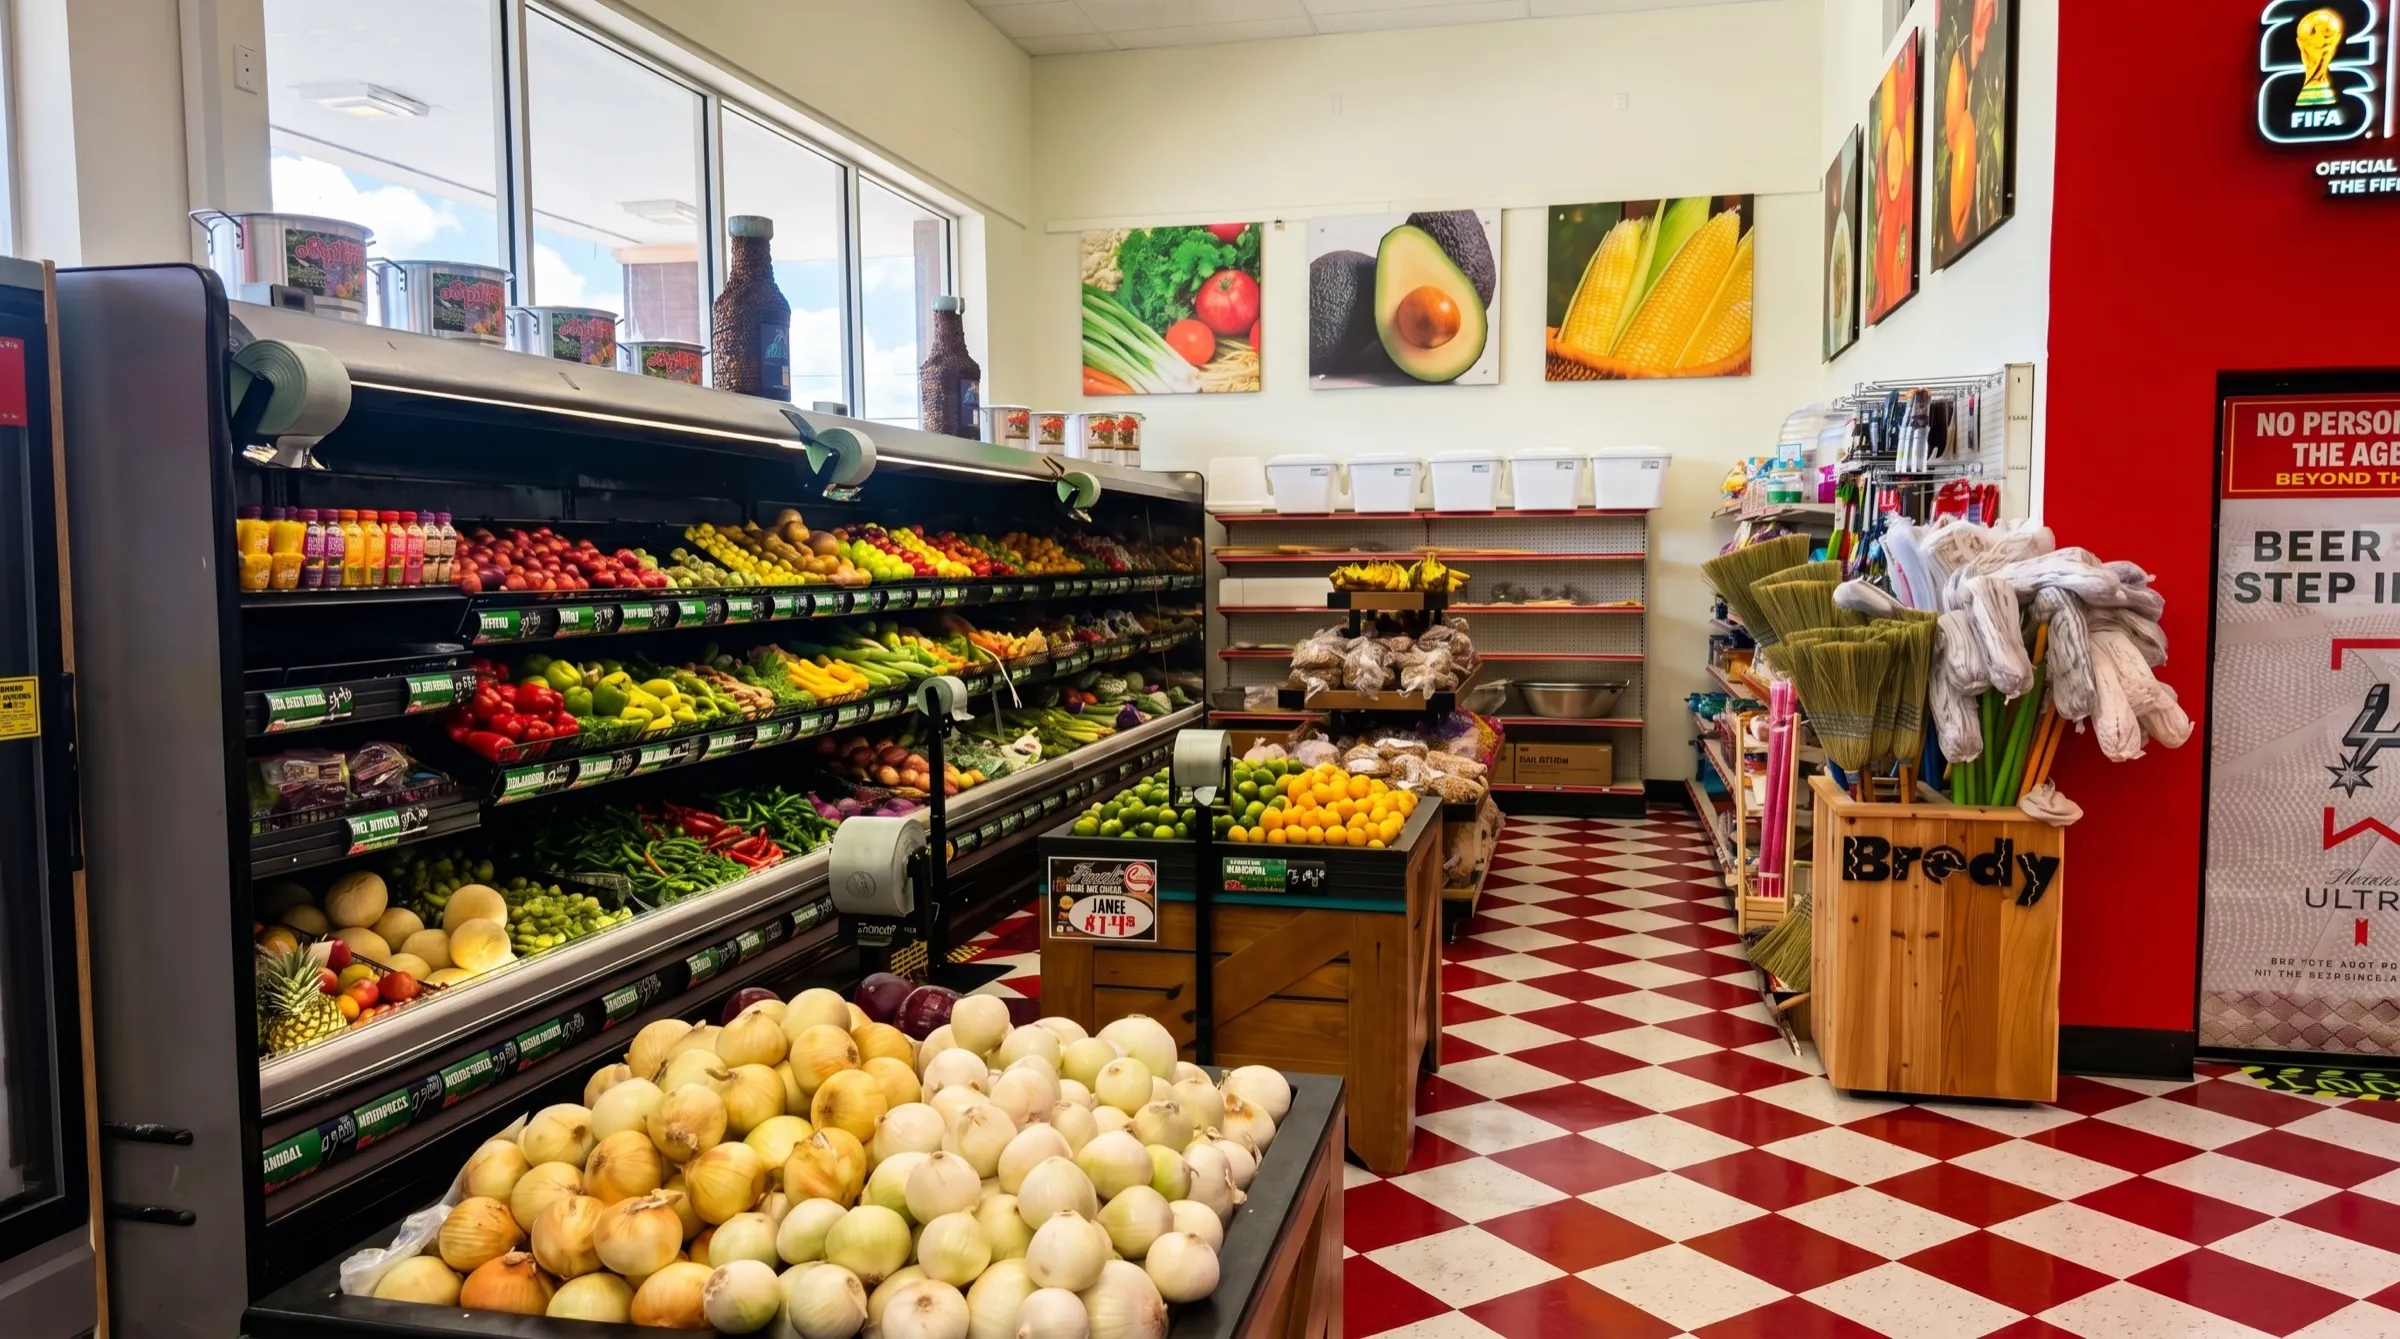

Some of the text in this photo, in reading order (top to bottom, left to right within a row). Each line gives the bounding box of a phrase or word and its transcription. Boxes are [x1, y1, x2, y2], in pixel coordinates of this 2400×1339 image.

[2291, 108, 2343, 128] FIFA
[2315, 158, 2398, 176] OFFICIAL
[2328, 179, 2366, 194] THE
[2256, 411, 2295, 437] NO
[2292, 441, 2345, 467] THE
[2276, 472, 2371, 486] BEYOND
[2253, 530, 2381, 562] BEER
[2233, 571, 2356, 604] STEP
